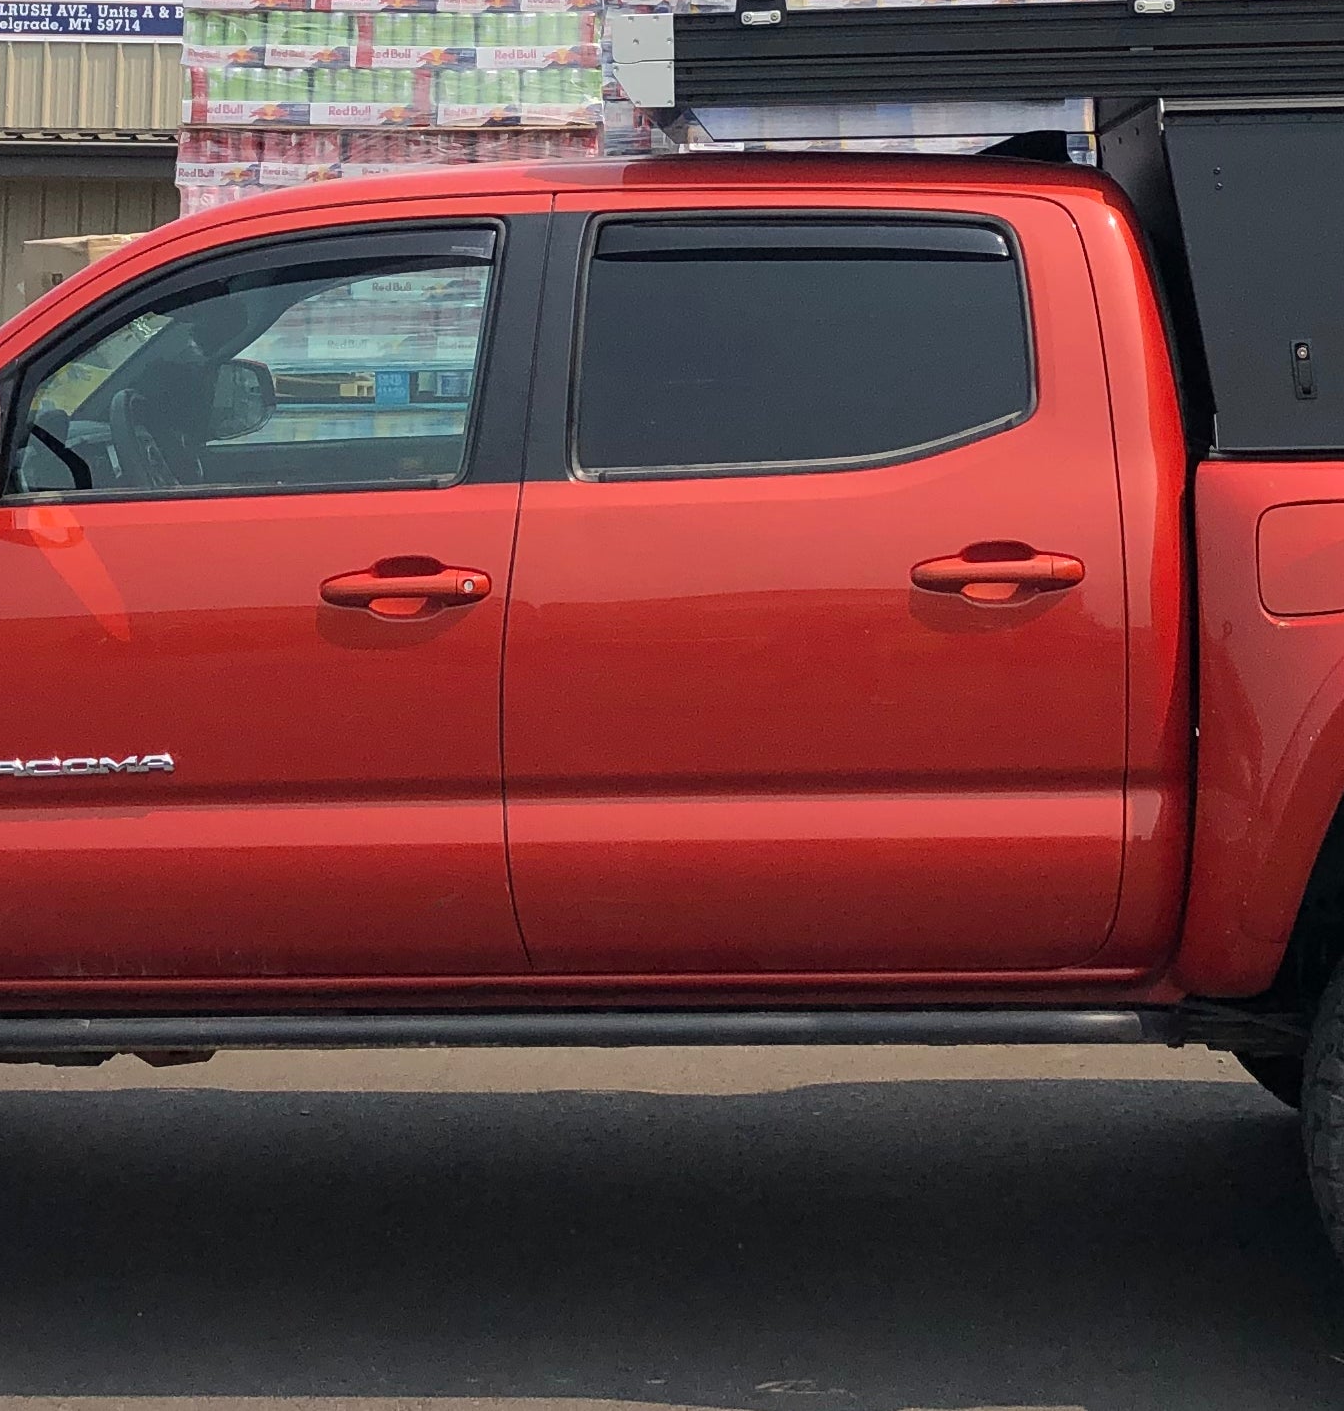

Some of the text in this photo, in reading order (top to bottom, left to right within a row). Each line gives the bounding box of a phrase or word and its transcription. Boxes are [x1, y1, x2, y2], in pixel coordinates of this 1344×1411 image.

[97, 4, 138, 19] Units
[142, 5, 154, 19] A
[158, 6, 170, 19] &
[174, 6, 184, 19] B
[68, 18, 93, 31] MT
[96, 19, 141, 32] 59714
[495, 49, 537, 60] Red Bull
[204, 104, 244, 114] ed Bull
[328, 105, 372, 115] Red Bull
[178, 168, 215, 178] Red Bull
[372, 281, 412, 292] Red Bull
